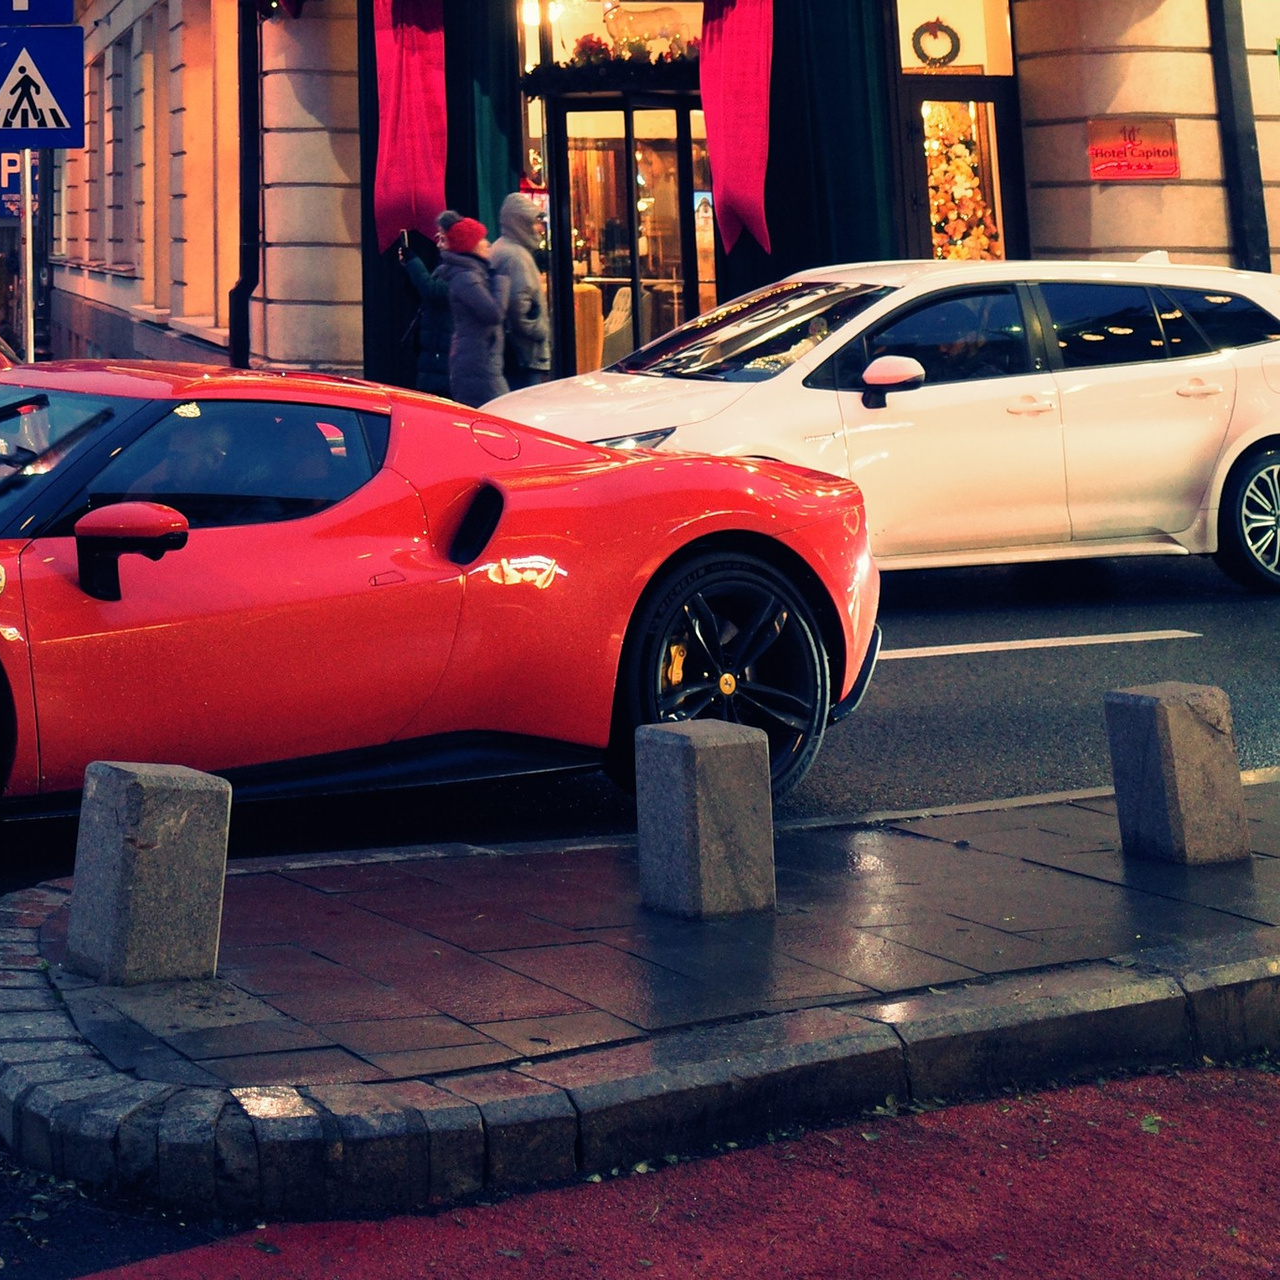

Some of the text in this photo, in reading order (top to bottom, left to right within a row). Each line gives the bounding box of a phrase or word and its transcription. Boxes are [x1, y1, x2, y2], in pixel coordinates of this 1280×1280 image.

[0, 152, 21, 188] P
[1094, 146, 1173, 159] Hotel Capitol
[657, 566, 706, 615] MICHELIN
